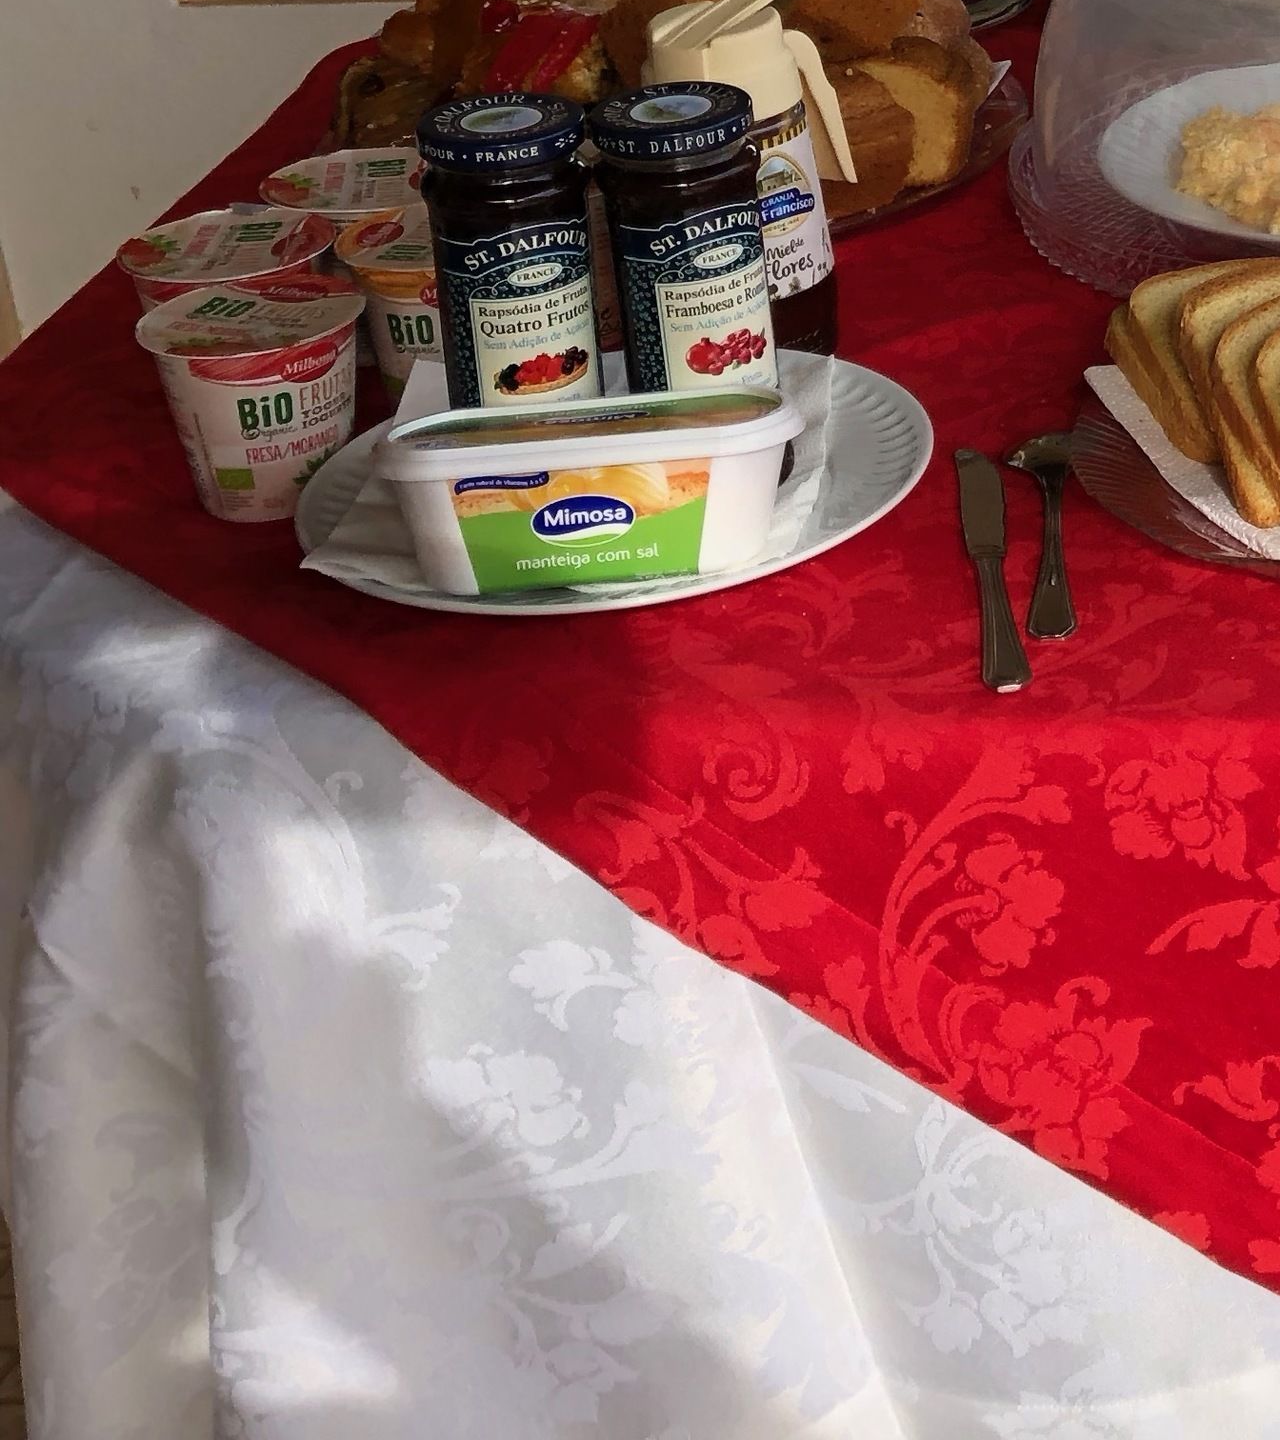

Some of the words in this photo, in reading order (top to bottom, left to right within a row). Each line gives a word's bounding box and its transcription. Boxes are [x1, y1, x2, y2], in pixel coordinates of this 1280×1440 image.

[618, 139, 641, 154] ST.
[649, 128, 727, 155] DALFOUR
[475, 146, 540, 163] FRANCE
[760, 191, 795, 209] GRANJA
[760, 197, 815, 222] Francisco
[650, 234, 683, 258] ST.
[684, 210, 761, 242] DALFOUR
[463, 248, 496, 272] ST.
[496, 229, 588, 258] DALFOUR
[702, 248, 739, 264] FRANCE
[766, 239, 797, 261] Miel
[516, 267, 556, 283] FRANCE
[478, 303, 542, 320] Rapsódia
[545, 298, 560, 310] de
[562, 284, 588, 305] Fruta
[664, 284, 726, 303] Rapsódia
[728, 279, 742, 291] de
[193, 296, 256, 318] BiO
[665, 297, 734, 319] Framboesa
[736, 294, 743, 305] e
[387, 313, 434, 345] BiO
[480, 320, 543, 339] Quatro
[547, 300, 590, 329] Frutos
[508, 333, 549, 349] Adição
[236, 391, 293, 430] BiO
[543, 507, 628, 528] Mimosa
[515, 552, 592, 571] manteiga
[596, 548, 632, 563] com
[636, 542, 660, 559] sal
